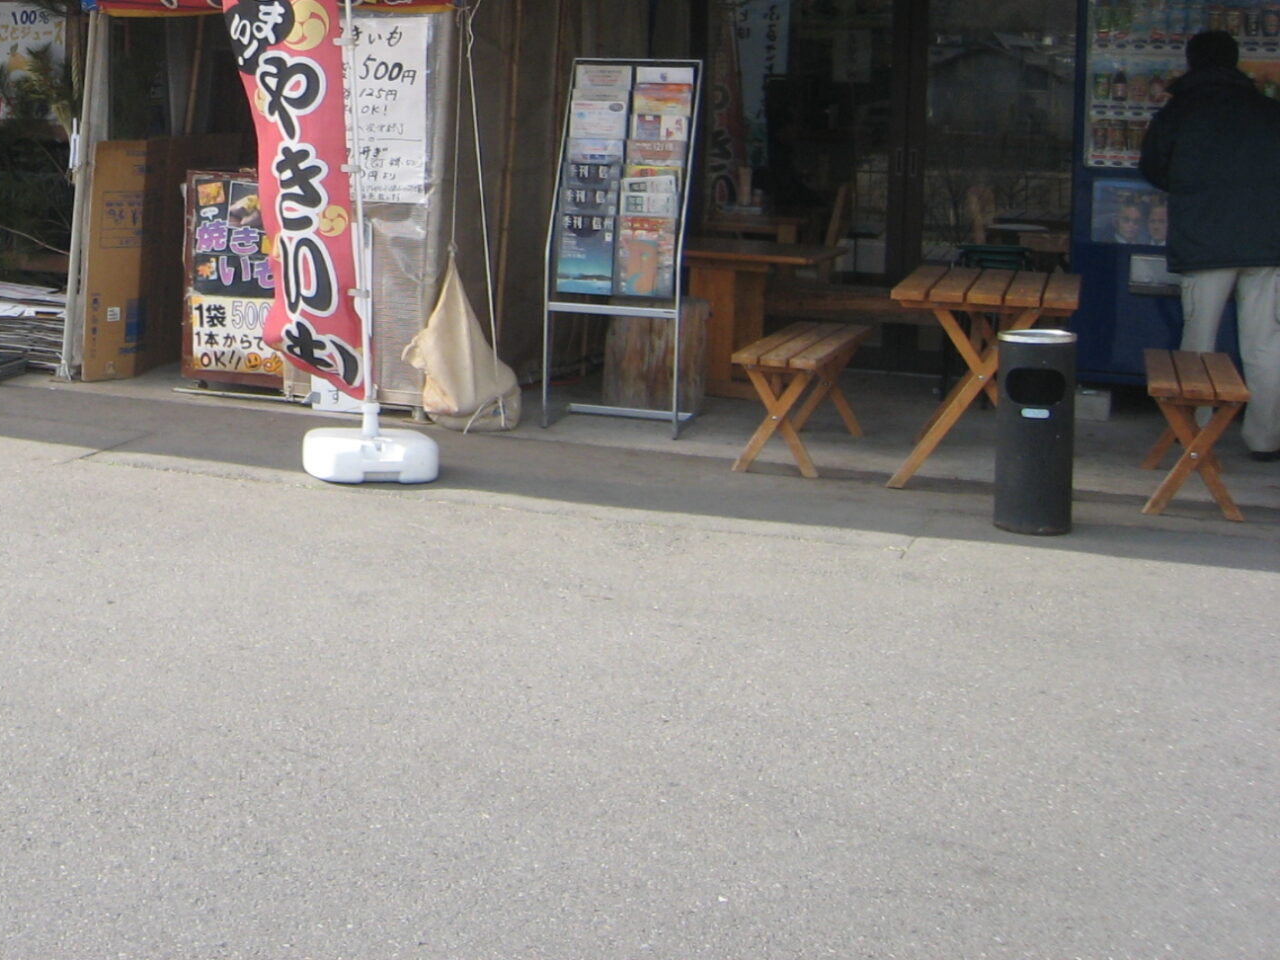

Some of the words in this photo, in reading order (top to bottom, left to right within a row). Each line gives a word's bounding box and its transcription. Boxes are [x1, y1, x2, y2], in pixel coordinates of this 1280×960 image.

[11, 10, 49, 25] 100%
[256, 50, 363, 388] やきいも
[196, 219, 260, 254] 焼き
[219, 255, 275, 288] いも
[194, 303, 226, 328] 1袋
